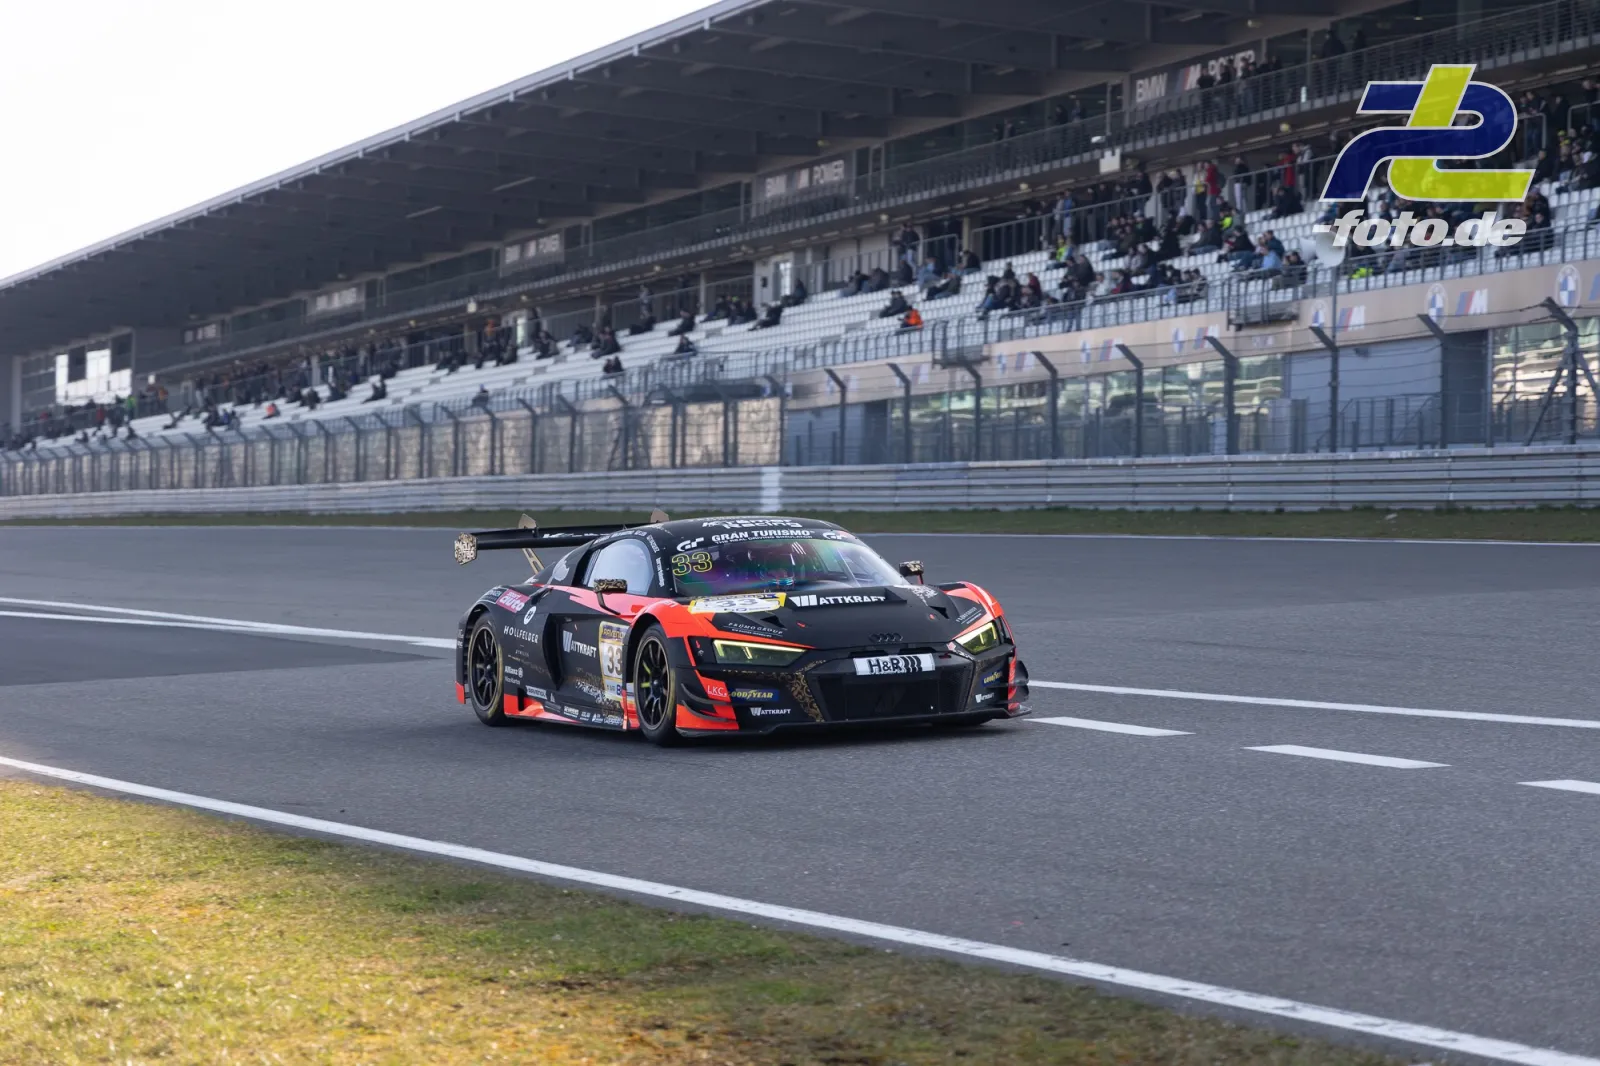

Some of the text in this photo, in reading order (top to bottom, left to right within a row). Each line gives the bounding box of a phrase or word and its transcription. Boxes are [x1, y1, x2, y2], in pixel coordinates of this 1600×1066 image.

[1136, 72, 1168, 102] BMW
[711, 529, 811, 543] GRAN TURISMO
[671, 551, 713, 575] 33
[503, 625, 539, 644] HOLLFELDER
[562, 630, 597, 658] WATTKRAFT
[505, 665, 518, 676] Allianz
[607, 645, 623, 676] 33
[750, 706, 791, 716] WATTKRAFT
